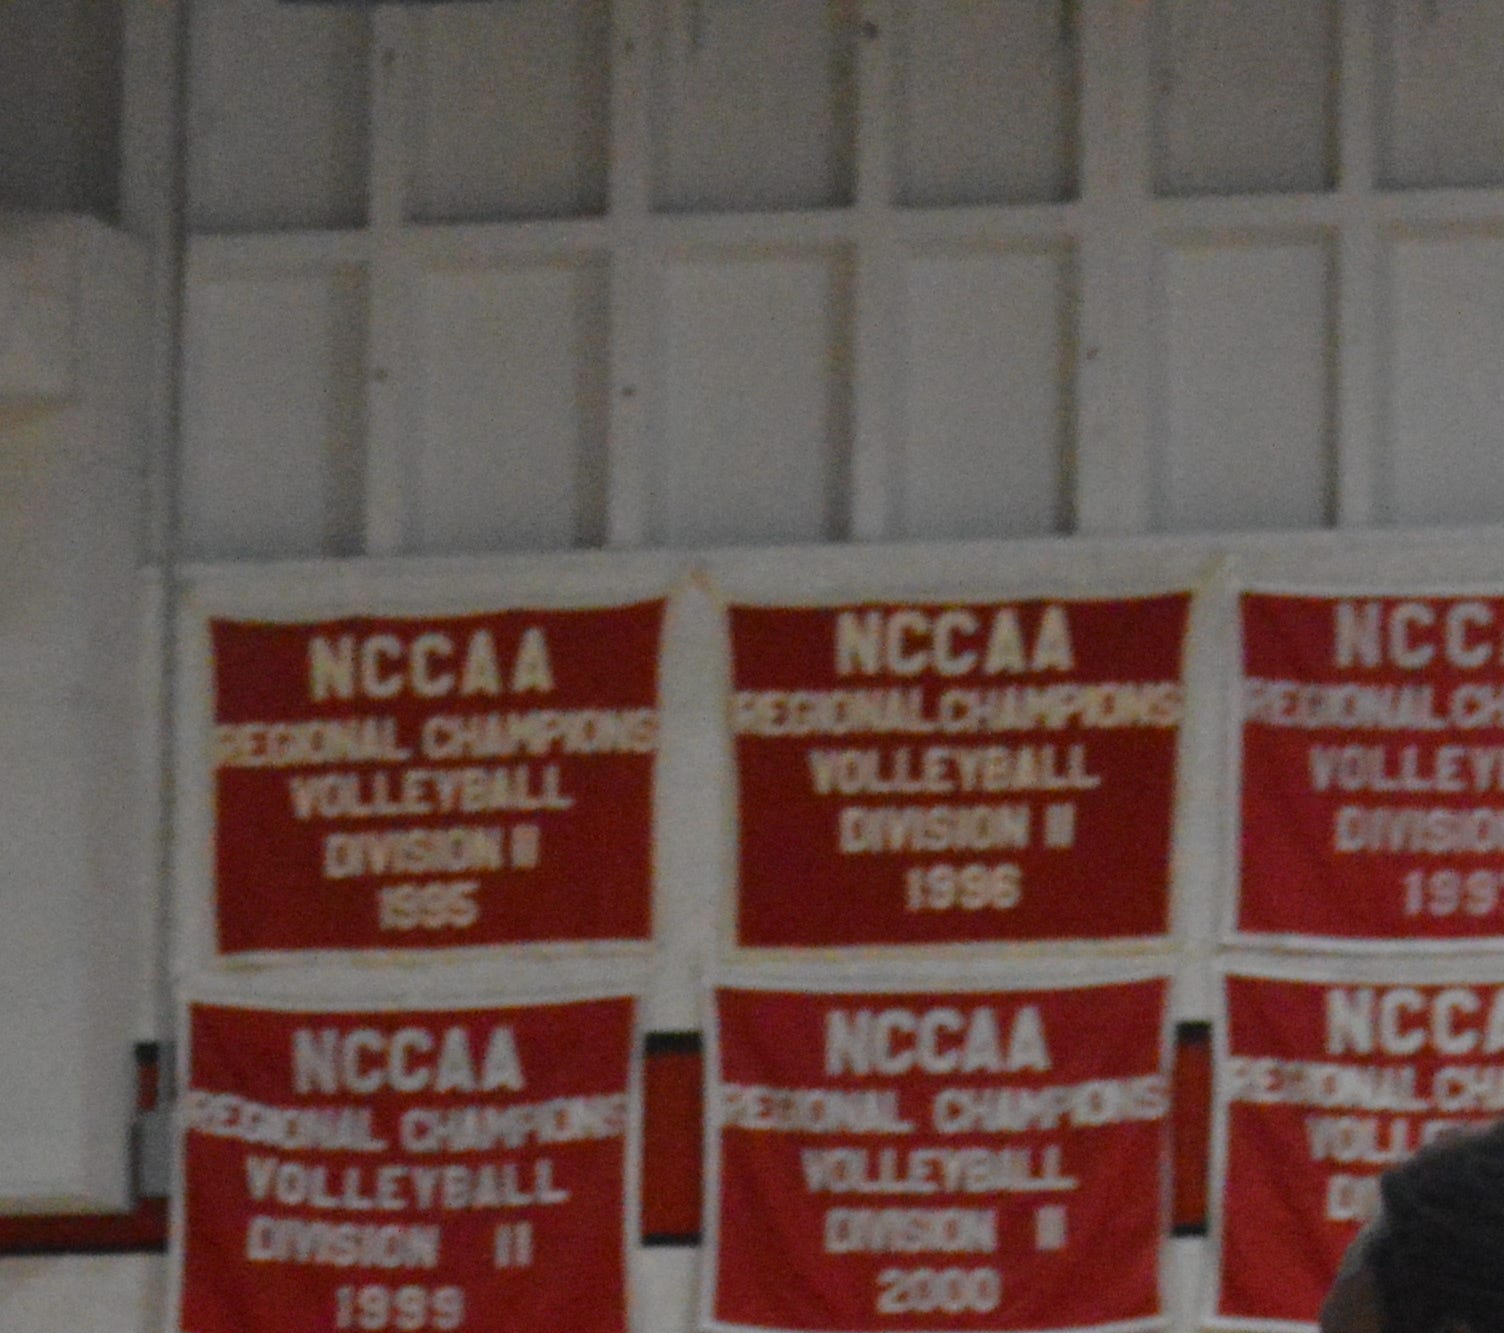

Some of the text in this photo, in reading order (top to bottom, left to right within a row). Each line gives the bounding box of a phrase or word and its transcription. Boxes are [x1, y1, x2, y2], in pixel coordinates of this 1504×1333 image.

[308, 625, 556, 701] NCCAA
[834, 604, 1075, 677] NCCAA
[732, 679, 1184, 736] REGIONAL CHAMPIONS
[1244, 677, 1448, 731] REGIONAL
[214, 708, 661, 769] REGIONAL CHAMPIONS
[291, 765, 577, 821] VOLLEYBALL
[809, 744, 1101, 795] VOLLEYBALL
[323, 825, 504, 880] DIVISION
[839, 802, 1031, 854] DIVISION
[291, 1024, 528, 1096] NCCAA
[824, 1005, 1053, 1077] NCCAA
[719, 1074, 1170, 1134] REGIONAL CHAMPIONS
[1227, 1054, 1431, 1112] REGIONAL
[186, 1089, 629, 1154] REGIONAL CHAMPIONS
[246, 1155, 572, 1211] VOLLEYBALL
[799, 1144, 1079, 1194] VOLLEYBALL
[245, 1215, 534, 1269] DIVISION II
[822, 1206, 999, 1255] DIVISION
[334, 1283, 466, 1332] 1999
[875, 1265, 1002, 1315] 2000
